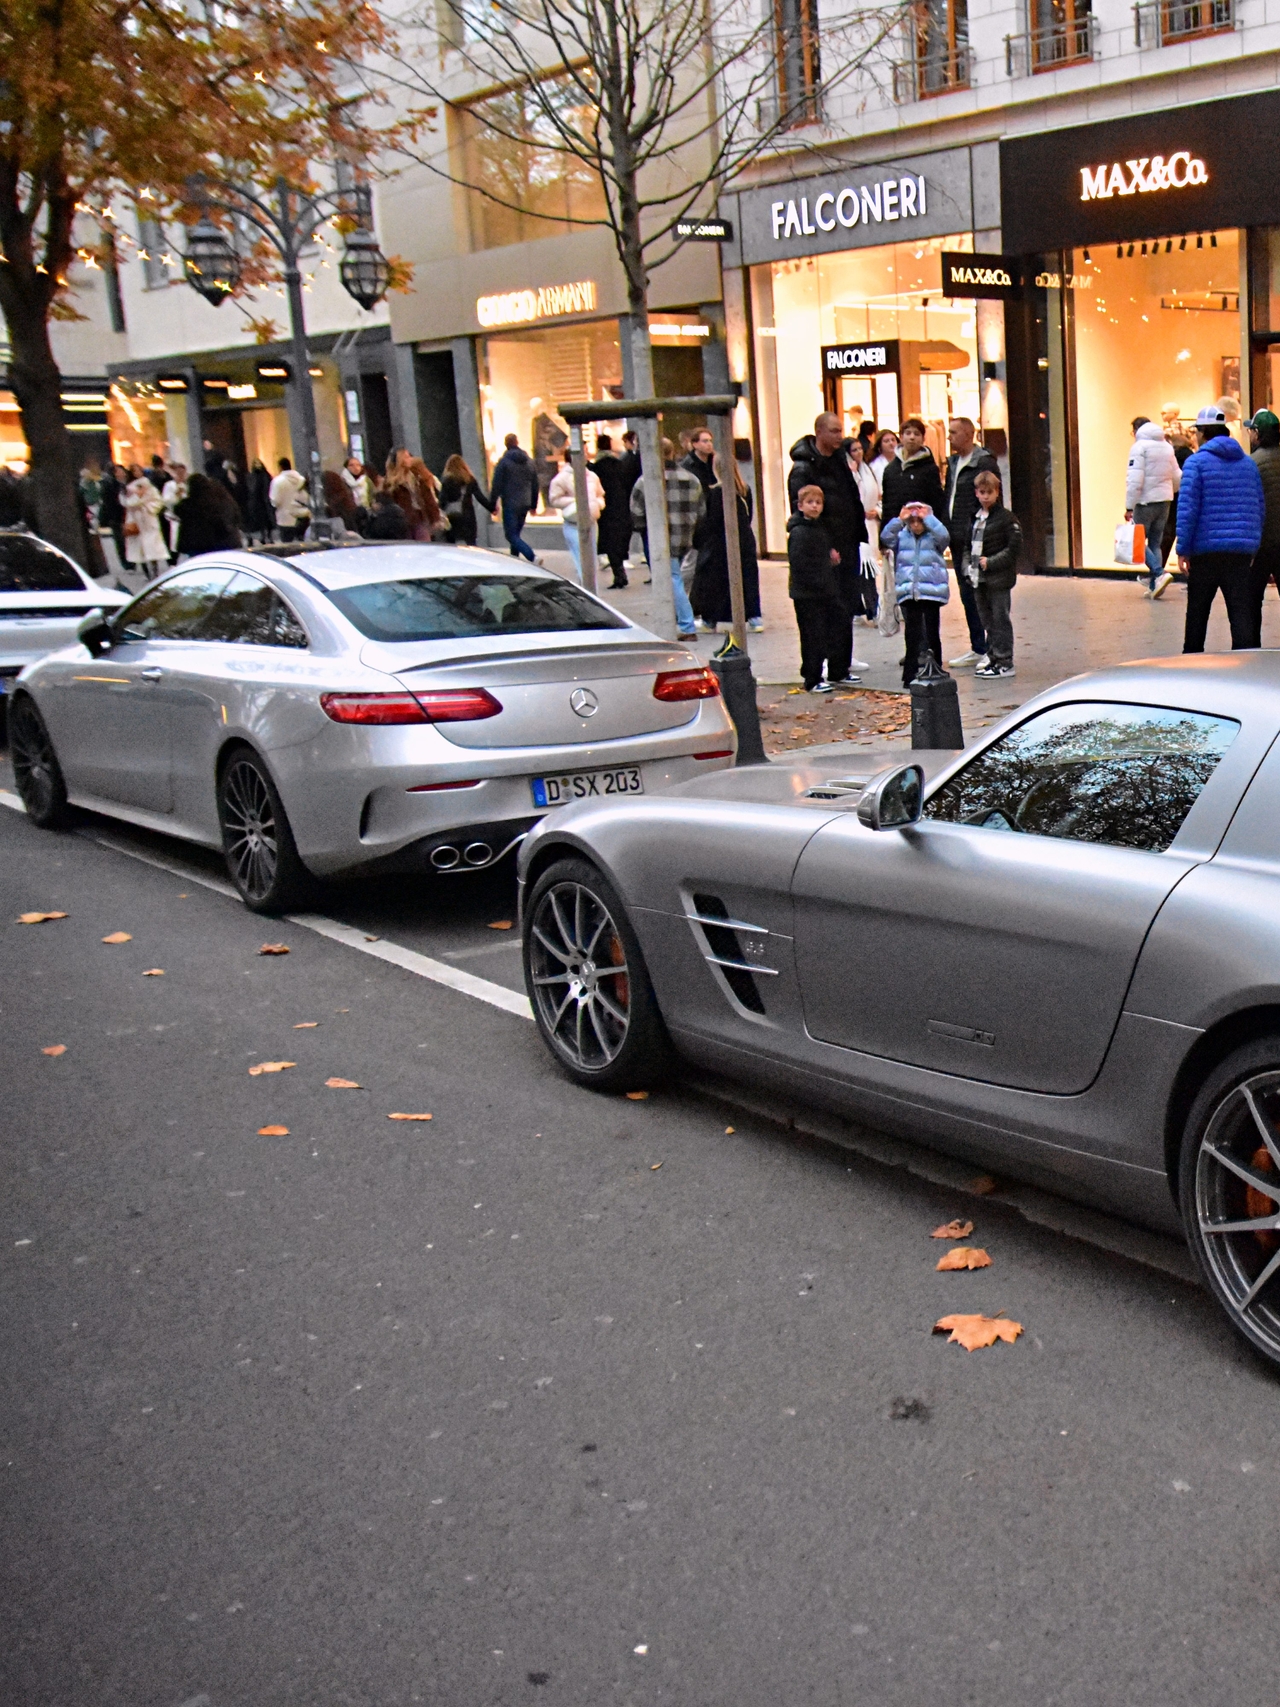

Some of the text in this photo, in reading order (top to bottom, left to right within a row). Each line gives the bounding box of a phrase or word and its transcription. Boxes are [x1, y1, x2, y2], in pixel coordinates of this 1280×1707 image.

[1080, 152, 1208, 200] MAX&Co.
[771, 175, 927, 240] FALCONERI
[950, 266, 1012, 286] MAX&Co.
[536, 280, 595, 318] ARMANI
[826, 347, 886, 369] FALCONERI
[546, 769, 640, 801] D SX 203
